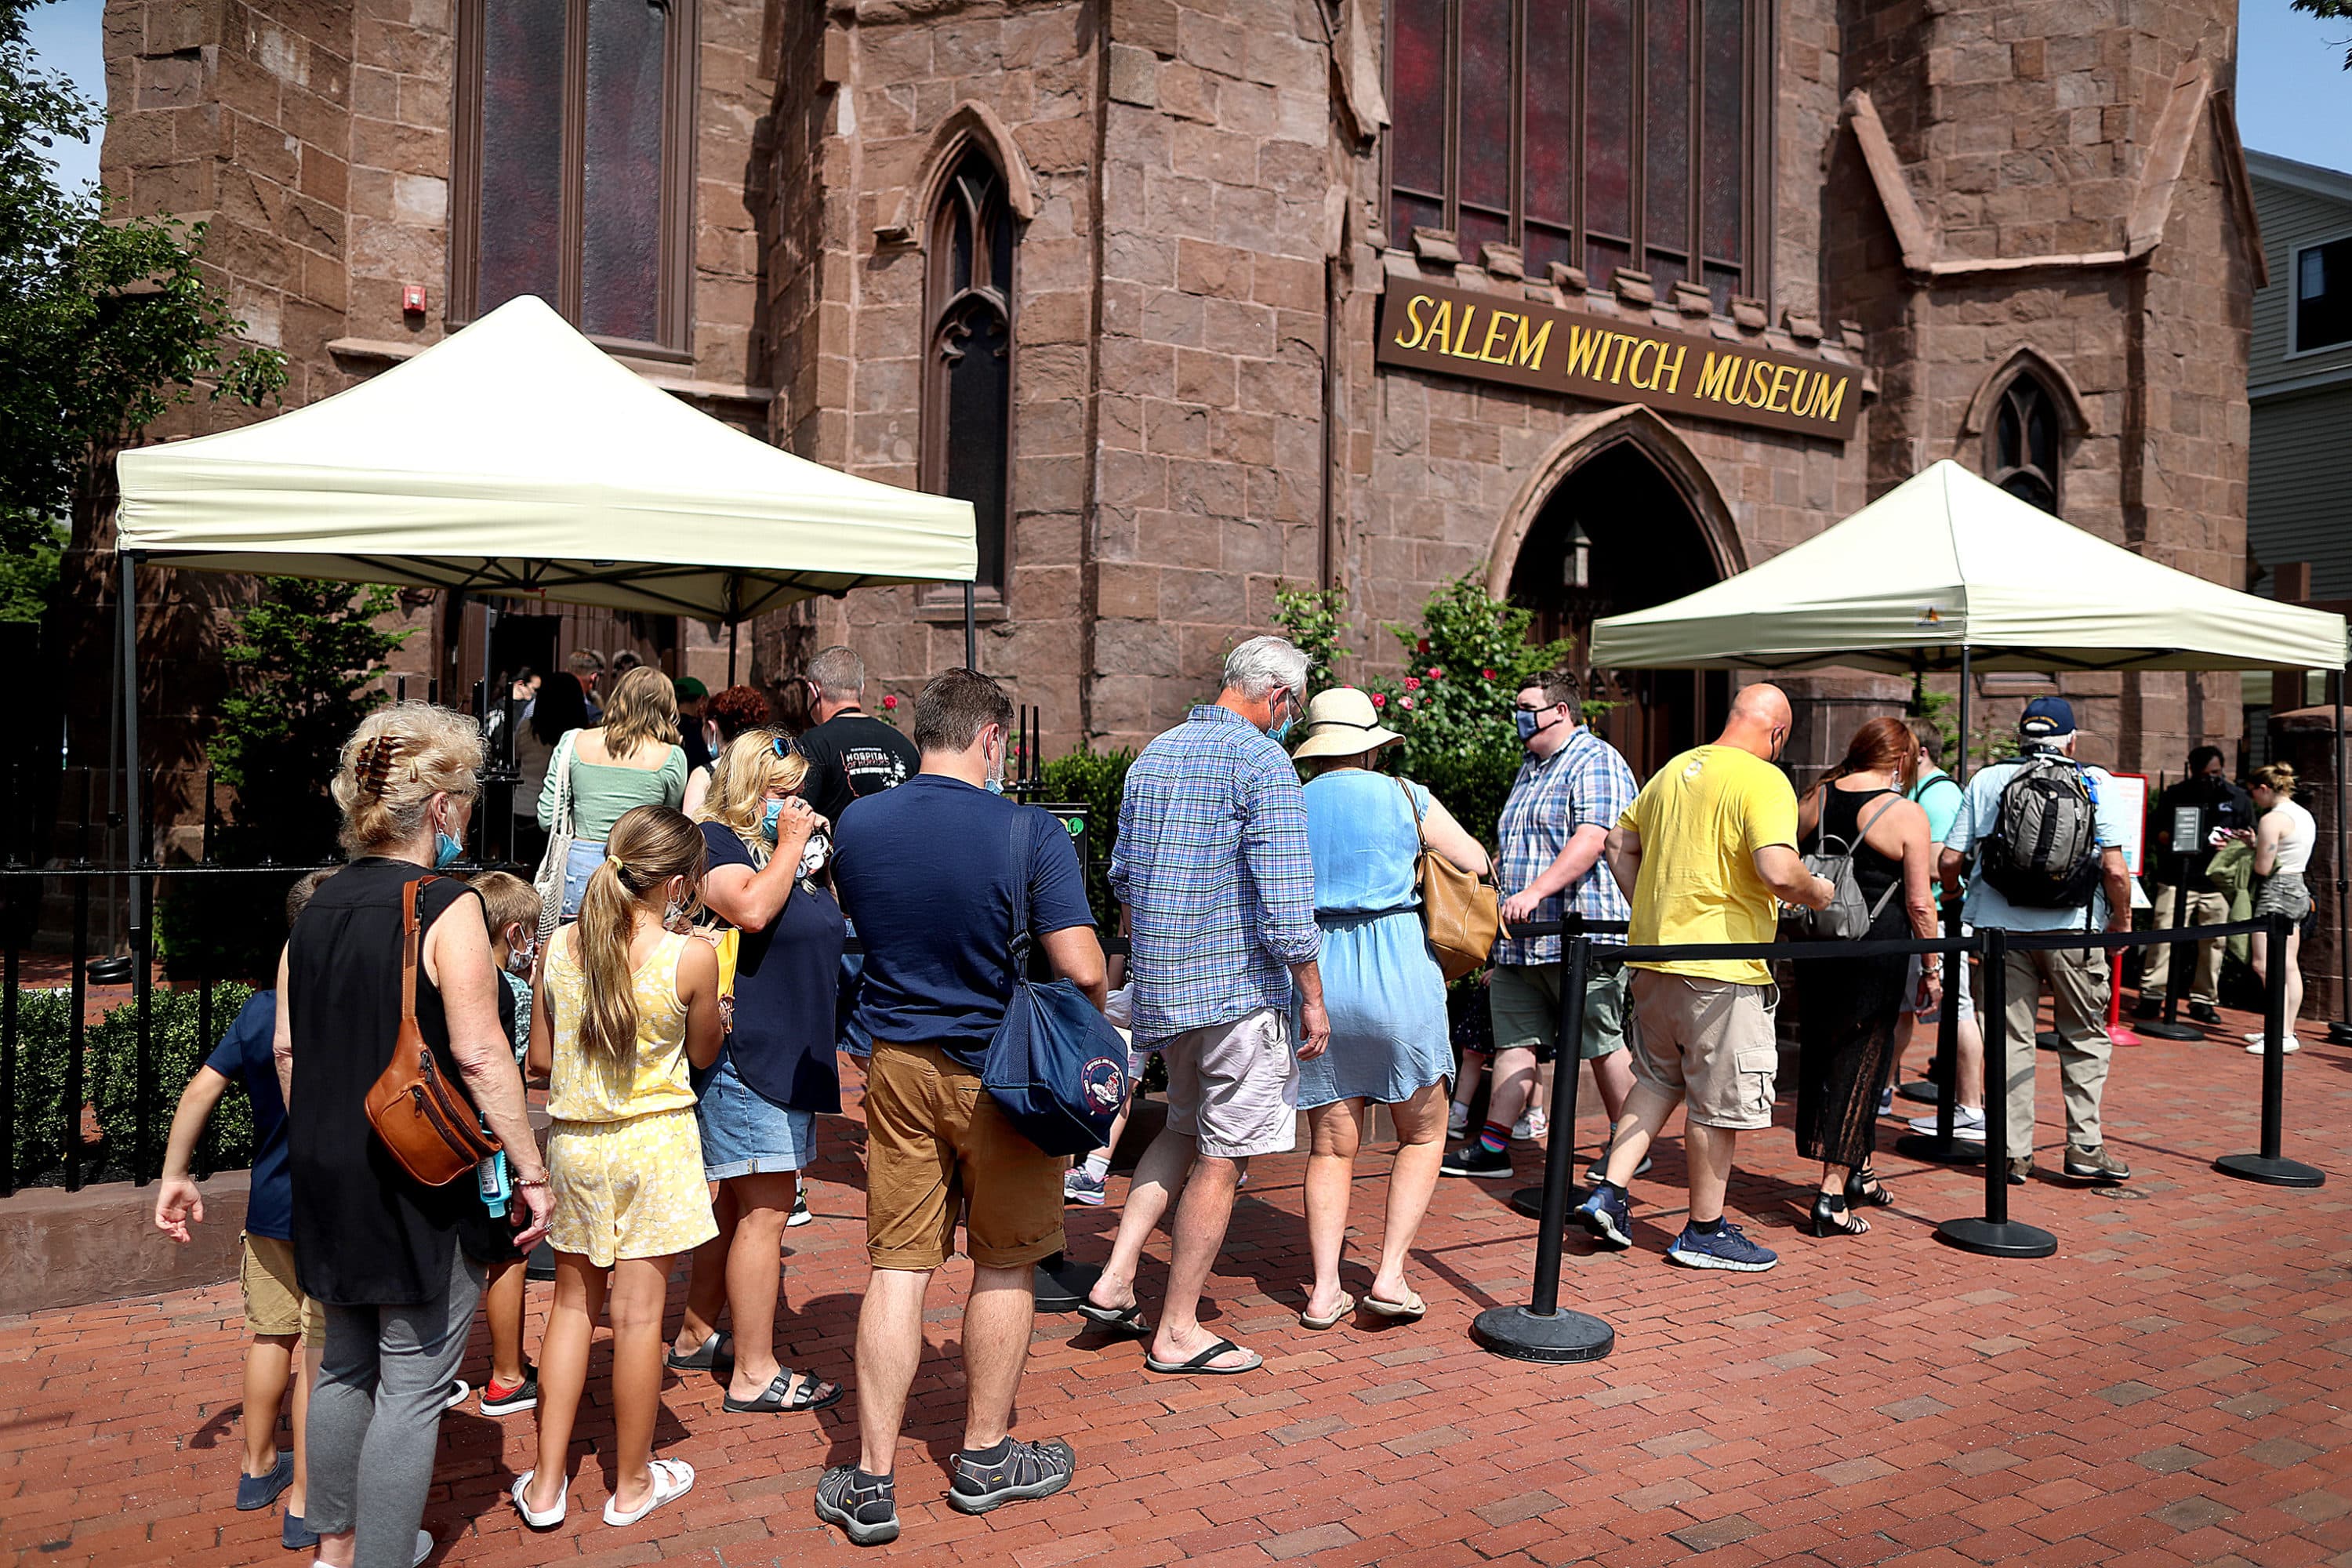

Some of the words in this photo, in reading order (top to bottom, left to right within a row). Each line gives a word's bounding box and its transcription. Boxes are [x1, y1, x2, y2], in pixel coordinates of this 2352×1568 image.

[1394, 294, 1555, 371] SALEM
[1566, 323, 1688, 394] WITCH
[1693, 350, 1849, 423] MUSEUM
[846, 752, 890, 763] HOSPITAL
